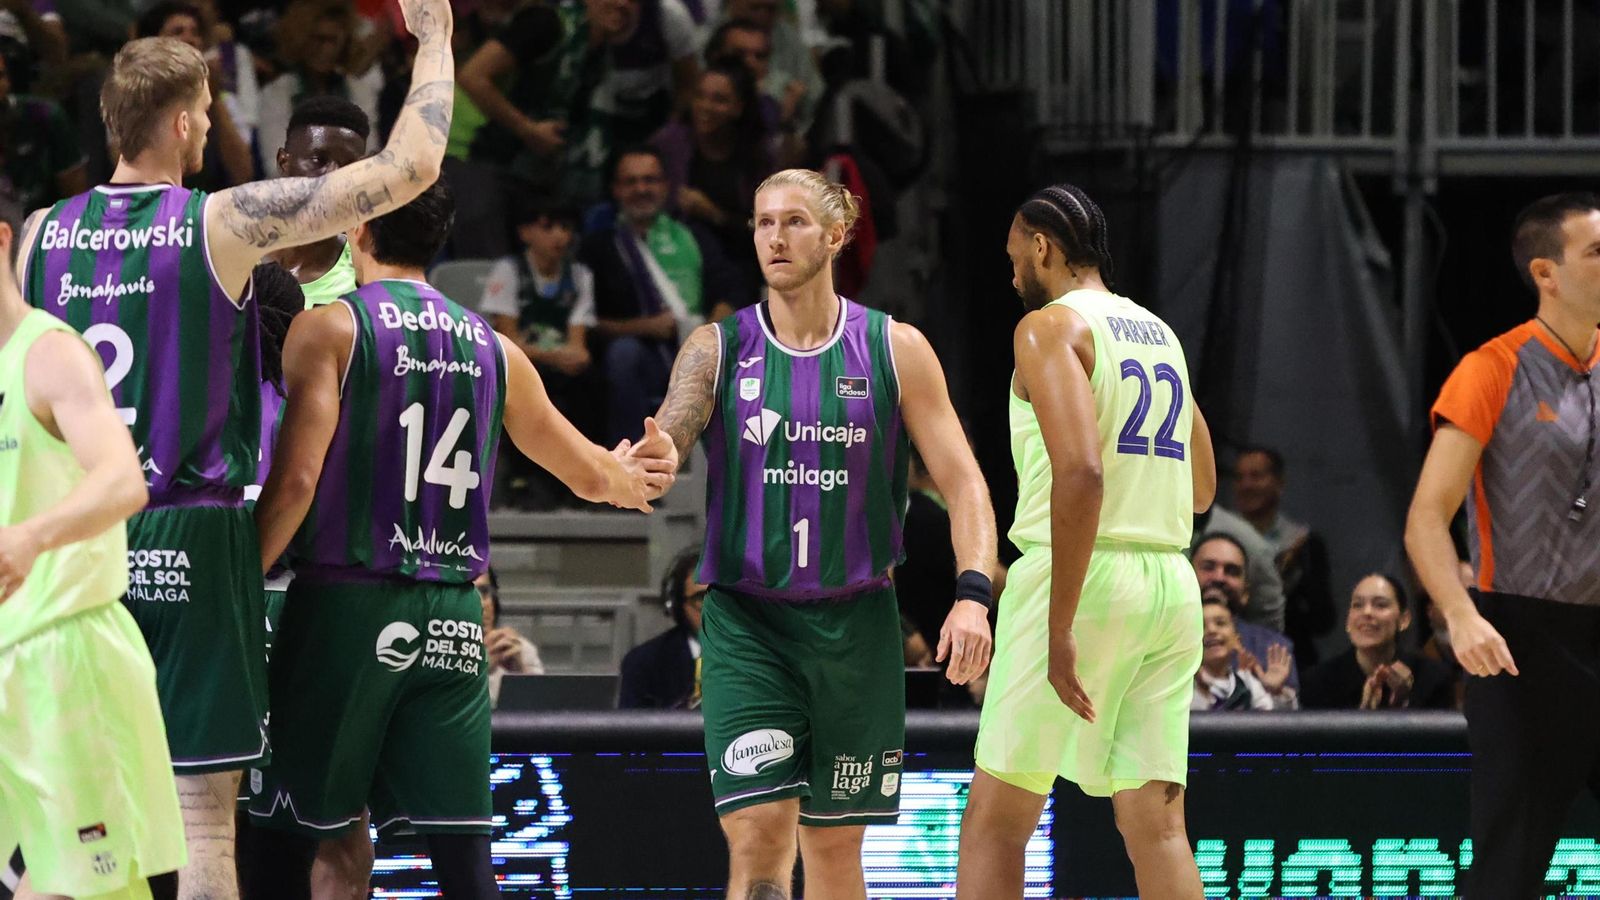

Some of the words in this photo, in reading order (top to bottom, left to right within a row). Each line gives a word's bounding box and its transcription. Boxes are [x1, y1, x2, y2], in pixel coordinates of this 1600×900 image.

[41, 217, 194, 250] Balcerowski
[1106, 316, 1171, 347] PARKER
[1116, 358, 1185, 462] 22
[784, 420, 867, 448] Unicaja
[399, 401, 480, 510] 14
[793, 518, 809, 568] 1
[153, 569, 191, 587] SOL
[427, 618, 483, 643] COSTA
[425, 638, 458, 655] DEL
[460, 641, 483, 661] SOL
[421, 653, 479, 676] MÁLAGA
[729, 732, 792, 769] famadesa
[834, 753, 857, 762] sabor
